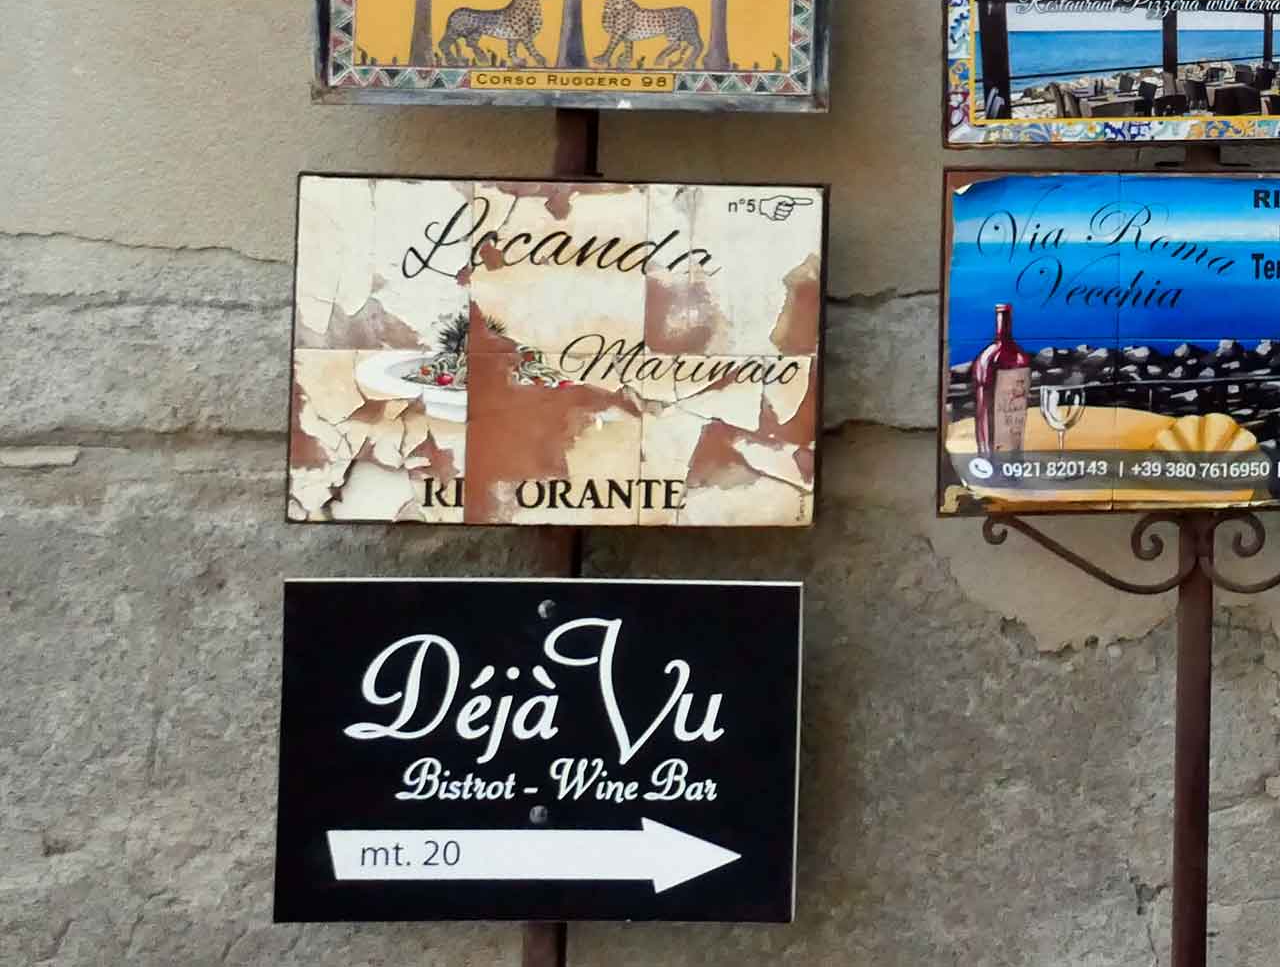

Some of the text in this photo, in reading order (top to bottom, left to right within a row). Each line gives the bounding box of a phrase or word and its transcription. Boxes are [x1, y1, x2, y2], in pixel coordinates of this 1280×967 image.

[641, 76, 667, 88] 98
[402, 197, 722, 278] Locanda
[976, 185, 1236, 277] Via Roma
[1015, 253, 1184, 310] Vecchia
[558, 334, 801, 385] Marinaio
[423, 478, 685, 509] RIORANTE
[1002, 462, 1042, 476] 0921
[1046, 461, 1107, 476] 820143
[1130, 462, 1162, 477] +39
[1165, 462, 1198, 477] 380
[1200, 461, 1270, 478] 7616950
[343, 618, 725, 764] Déjà Vu
[396, 758, 515, 802] Bistrot
[549, 758, 638, 804] Wine
[643, 759, 718, 802] Bar
[360, 840, 461, 867] mt. 20
